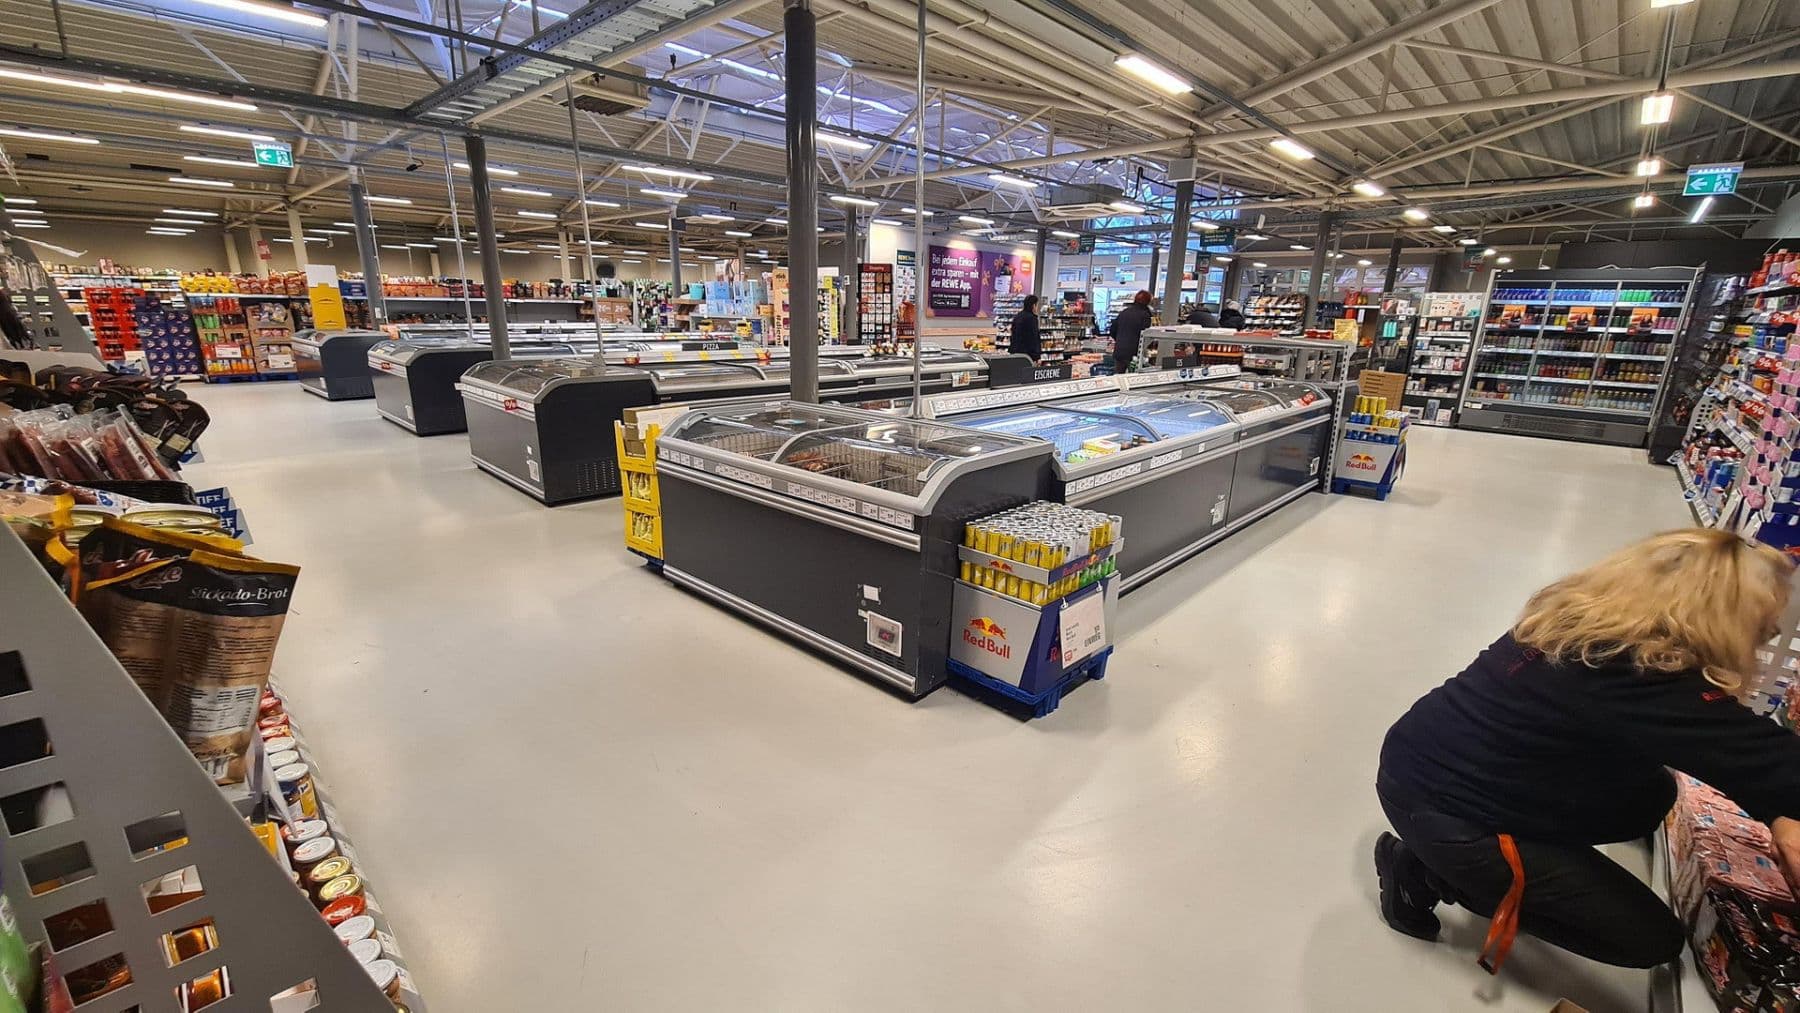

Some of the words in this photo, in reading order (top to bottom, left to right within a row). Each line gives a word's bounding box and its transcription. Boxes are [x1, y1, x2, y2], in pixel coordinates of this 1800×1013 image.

[941, 256, 958, 267] jedem
[958, 256, 978, 268] Einkauf
[931, 269, 947, 277] extra
[947, 270, 965, 280] sparen
[969, 271, 979, 279] mit
[931, 279, 941, 288] der
[941, 280, 959, 290] REWE
[1034, 368, 1061, 381] EISCREME
[1346, 461, 1361, 469] Red
[1361, 462, 1376, 470] Bull
[190, 587, 288, 602] Stickado-Brot
[963, 629, 986, 649] Red
[987, 638, 1011, 659] Bull
